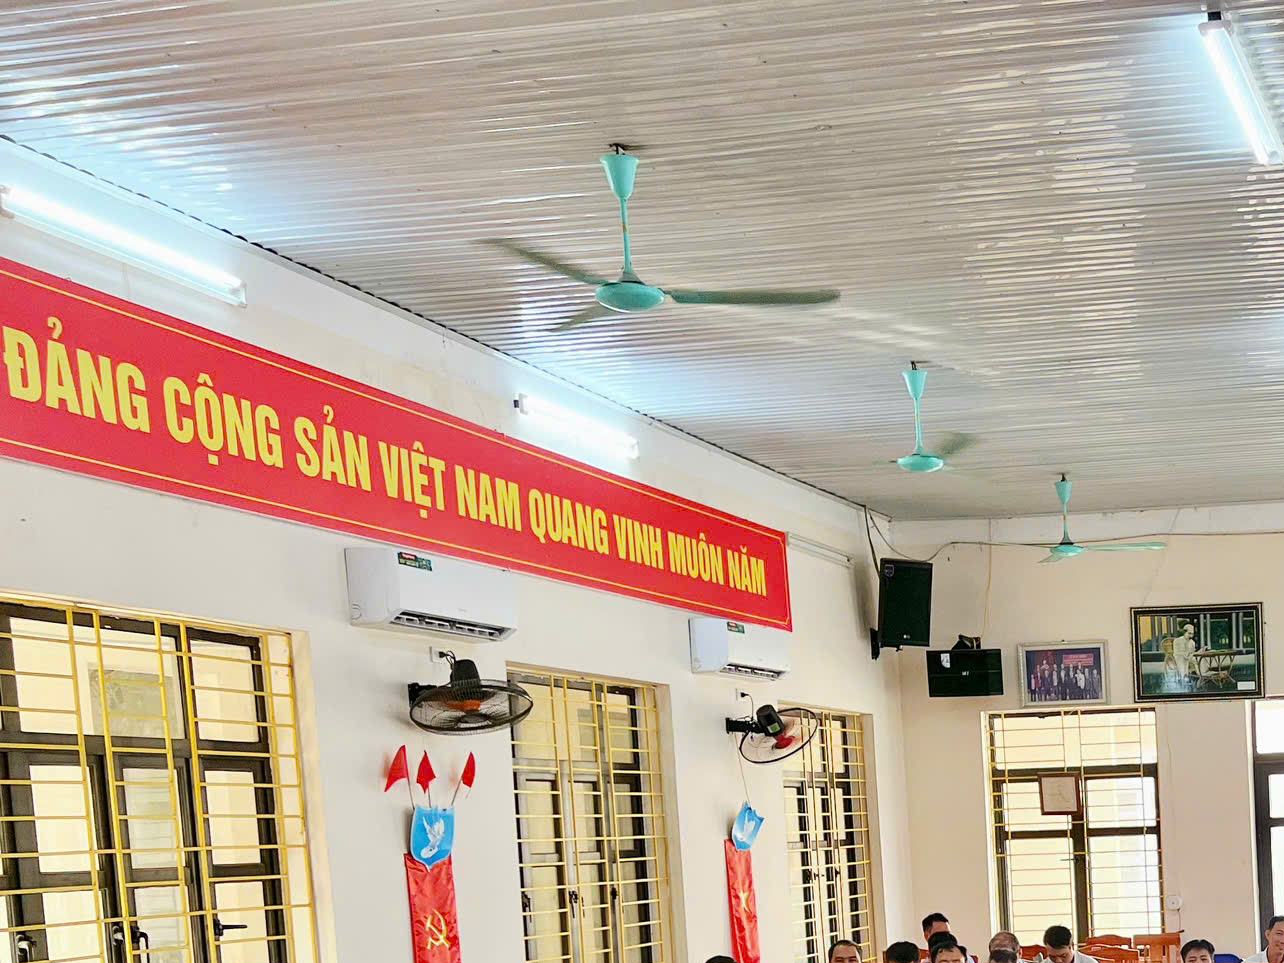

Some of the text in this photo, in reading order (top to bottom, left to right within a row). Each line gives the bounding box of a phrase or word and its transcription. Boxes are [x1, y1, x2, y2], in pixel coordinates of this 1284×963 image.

[3, 316, 767, 597] ĐẢNG CỘNG SẢN VIỆT NAM QUANG VINH MUÔN NĂM
